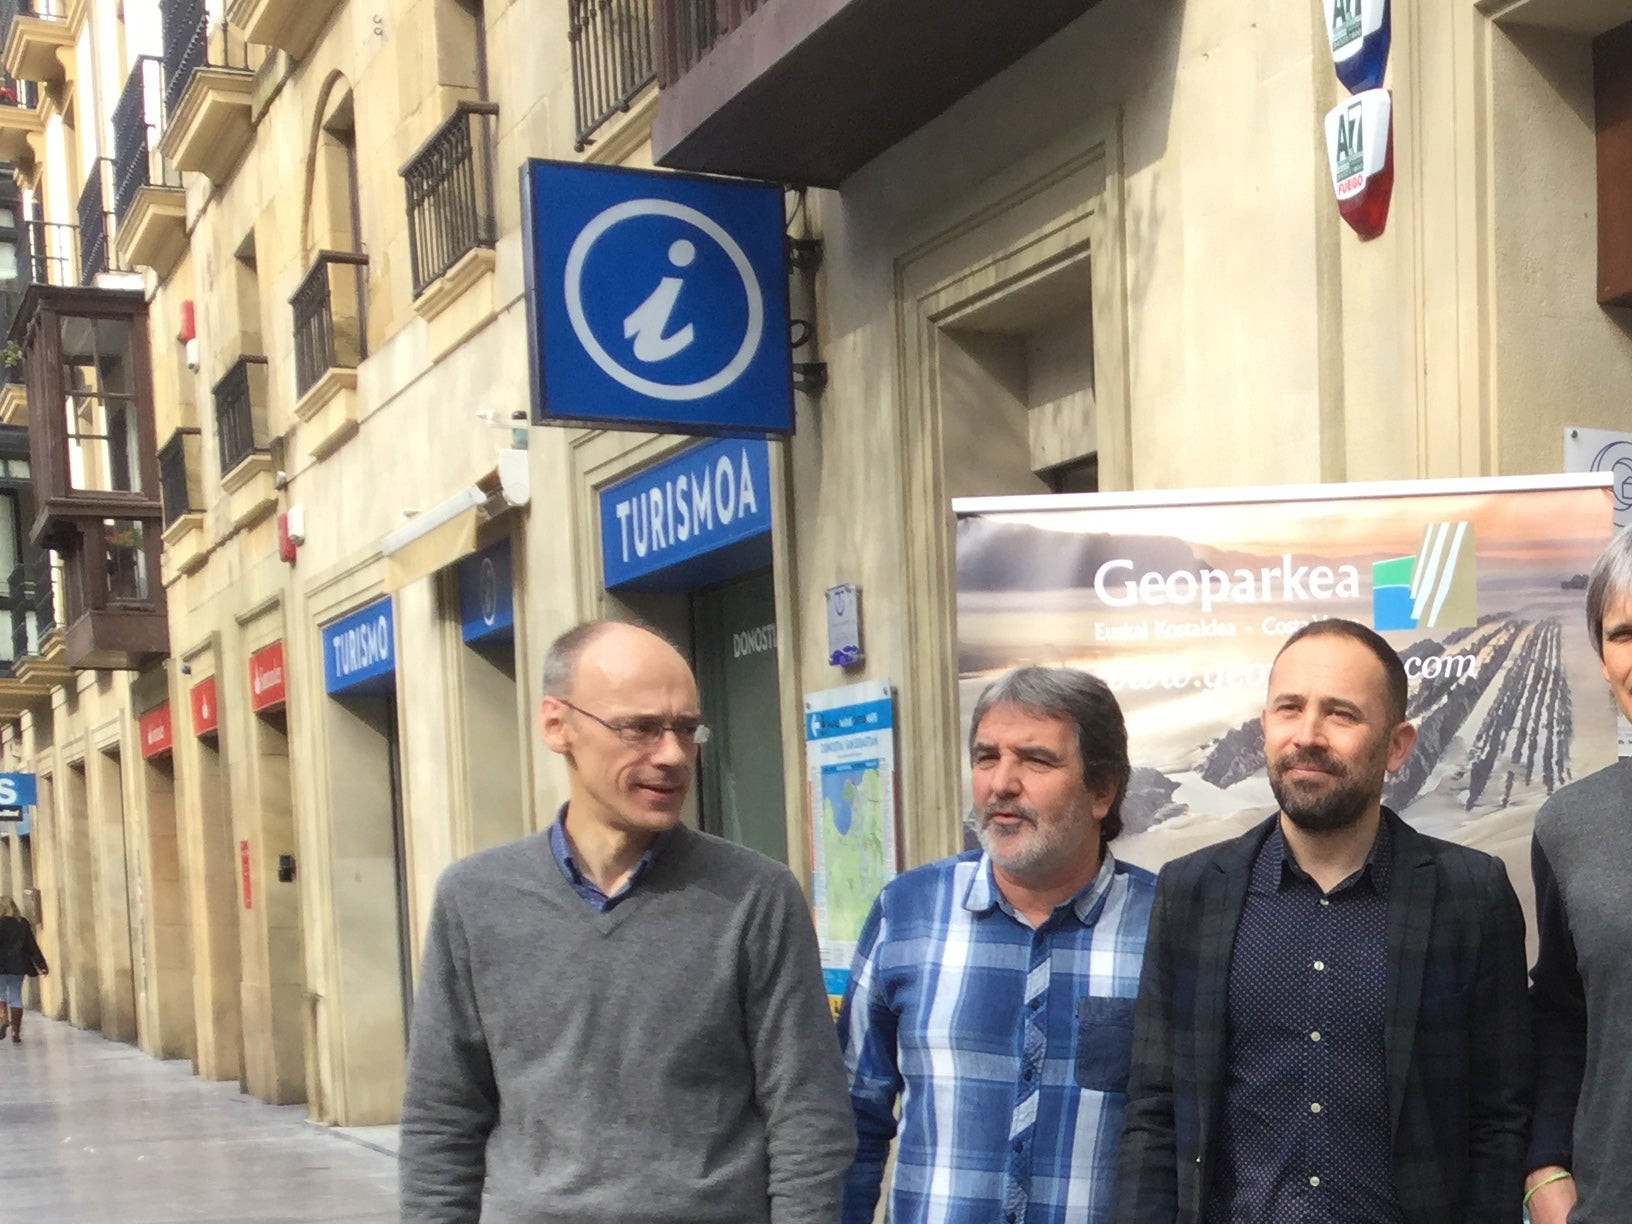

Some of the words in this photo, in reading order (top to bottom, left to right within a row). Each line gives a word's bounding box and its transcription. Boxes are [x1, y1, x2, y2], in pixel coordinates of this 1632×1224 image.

[1338, 173, 1364, 196] FUEGO
[615, 447, 758, 563] TURISMOA
[1094, 553, 1360, 613] Geoparkea
[333, 615, 388, 677] TURISMO
